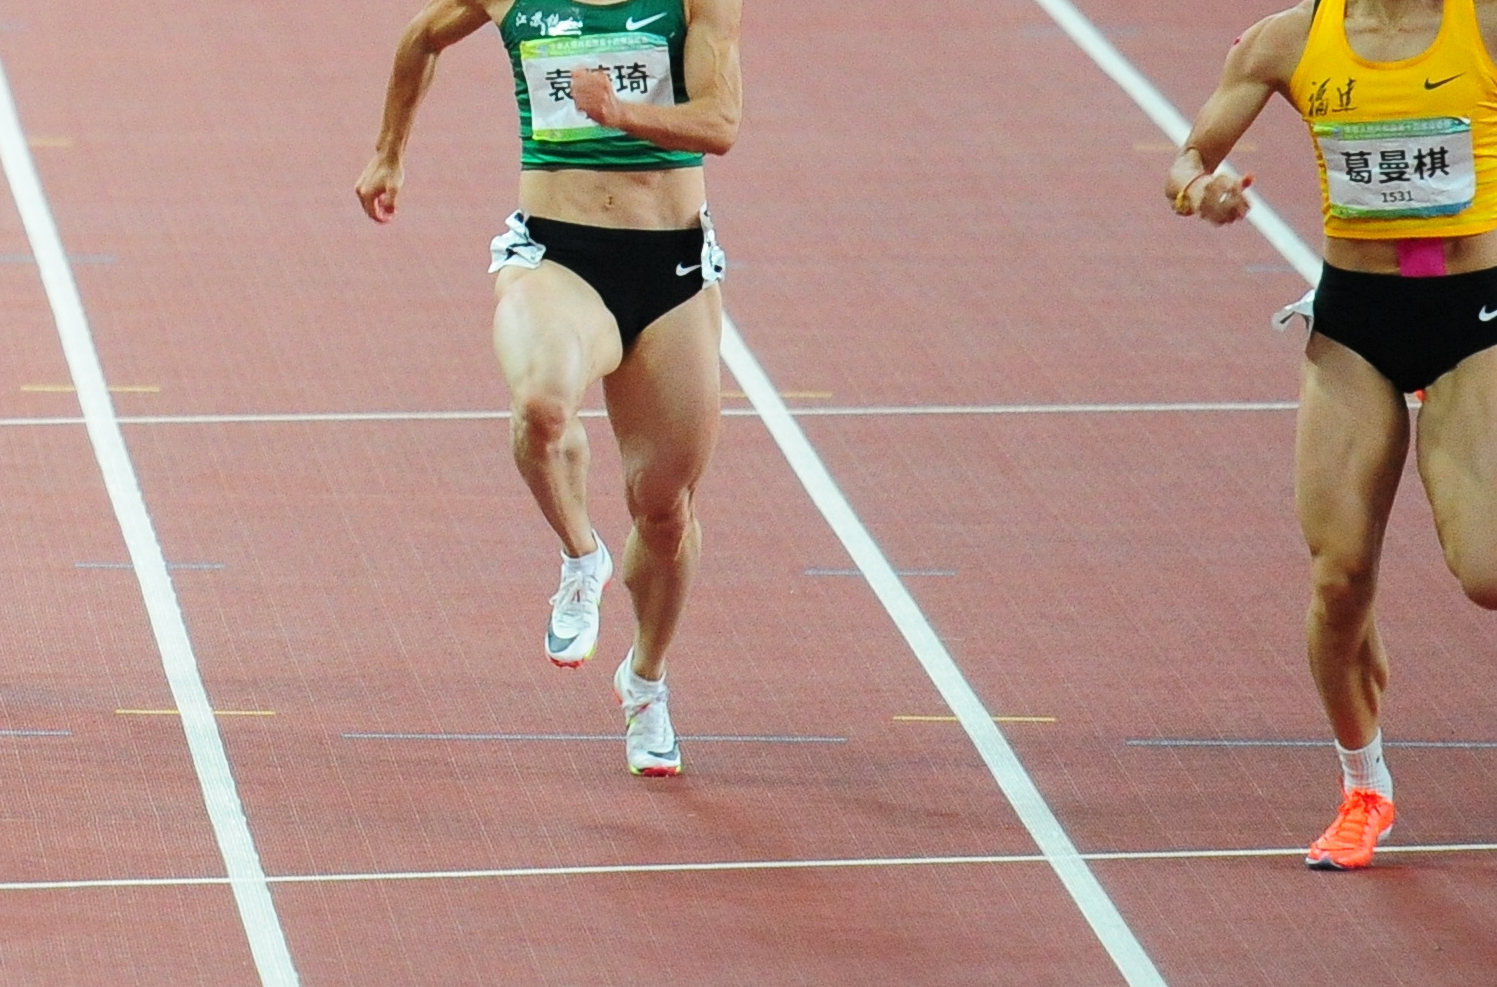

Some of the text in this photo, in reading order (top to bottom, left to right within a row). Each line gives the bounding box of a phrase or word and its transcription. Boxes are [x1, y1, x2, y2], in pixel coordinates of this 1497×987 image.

[545, 62, 649, 102] 袁琦
[1339, 146, 1450, 184] 葛曼棋
[1380, 190, 1415, 204] 1531
